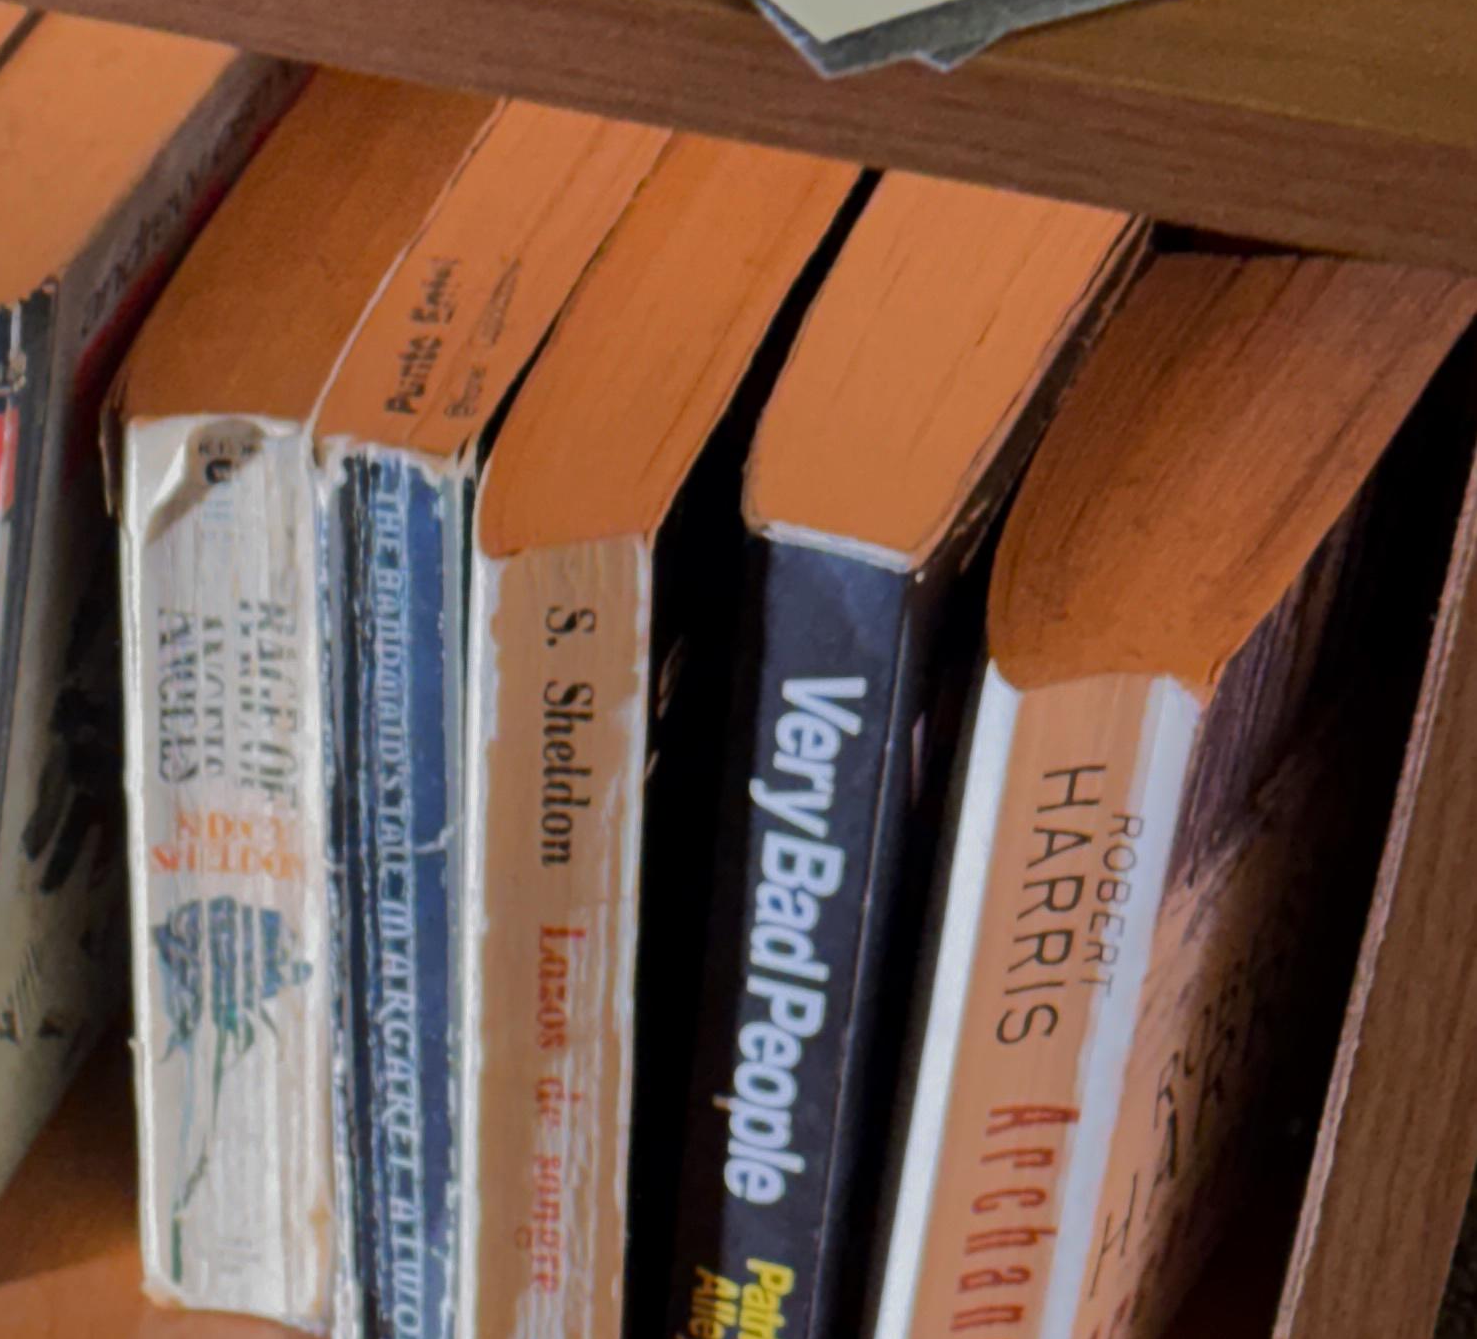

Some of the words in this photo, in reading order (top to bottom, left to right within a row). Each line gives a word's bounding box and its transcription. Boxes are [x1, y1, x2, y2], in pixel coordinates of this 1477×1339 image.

[546, 606, 596, 647] S.
[541, 681, 594, 867] Sheldon
[749, 677, 867, 837] Very
[748, 831, 845, 983] Bad
[996, 762, 1108, 1047] HARRIS
[1079, 812, 1145, 996] ROBERT
[715, 971, 824, 1204] People
